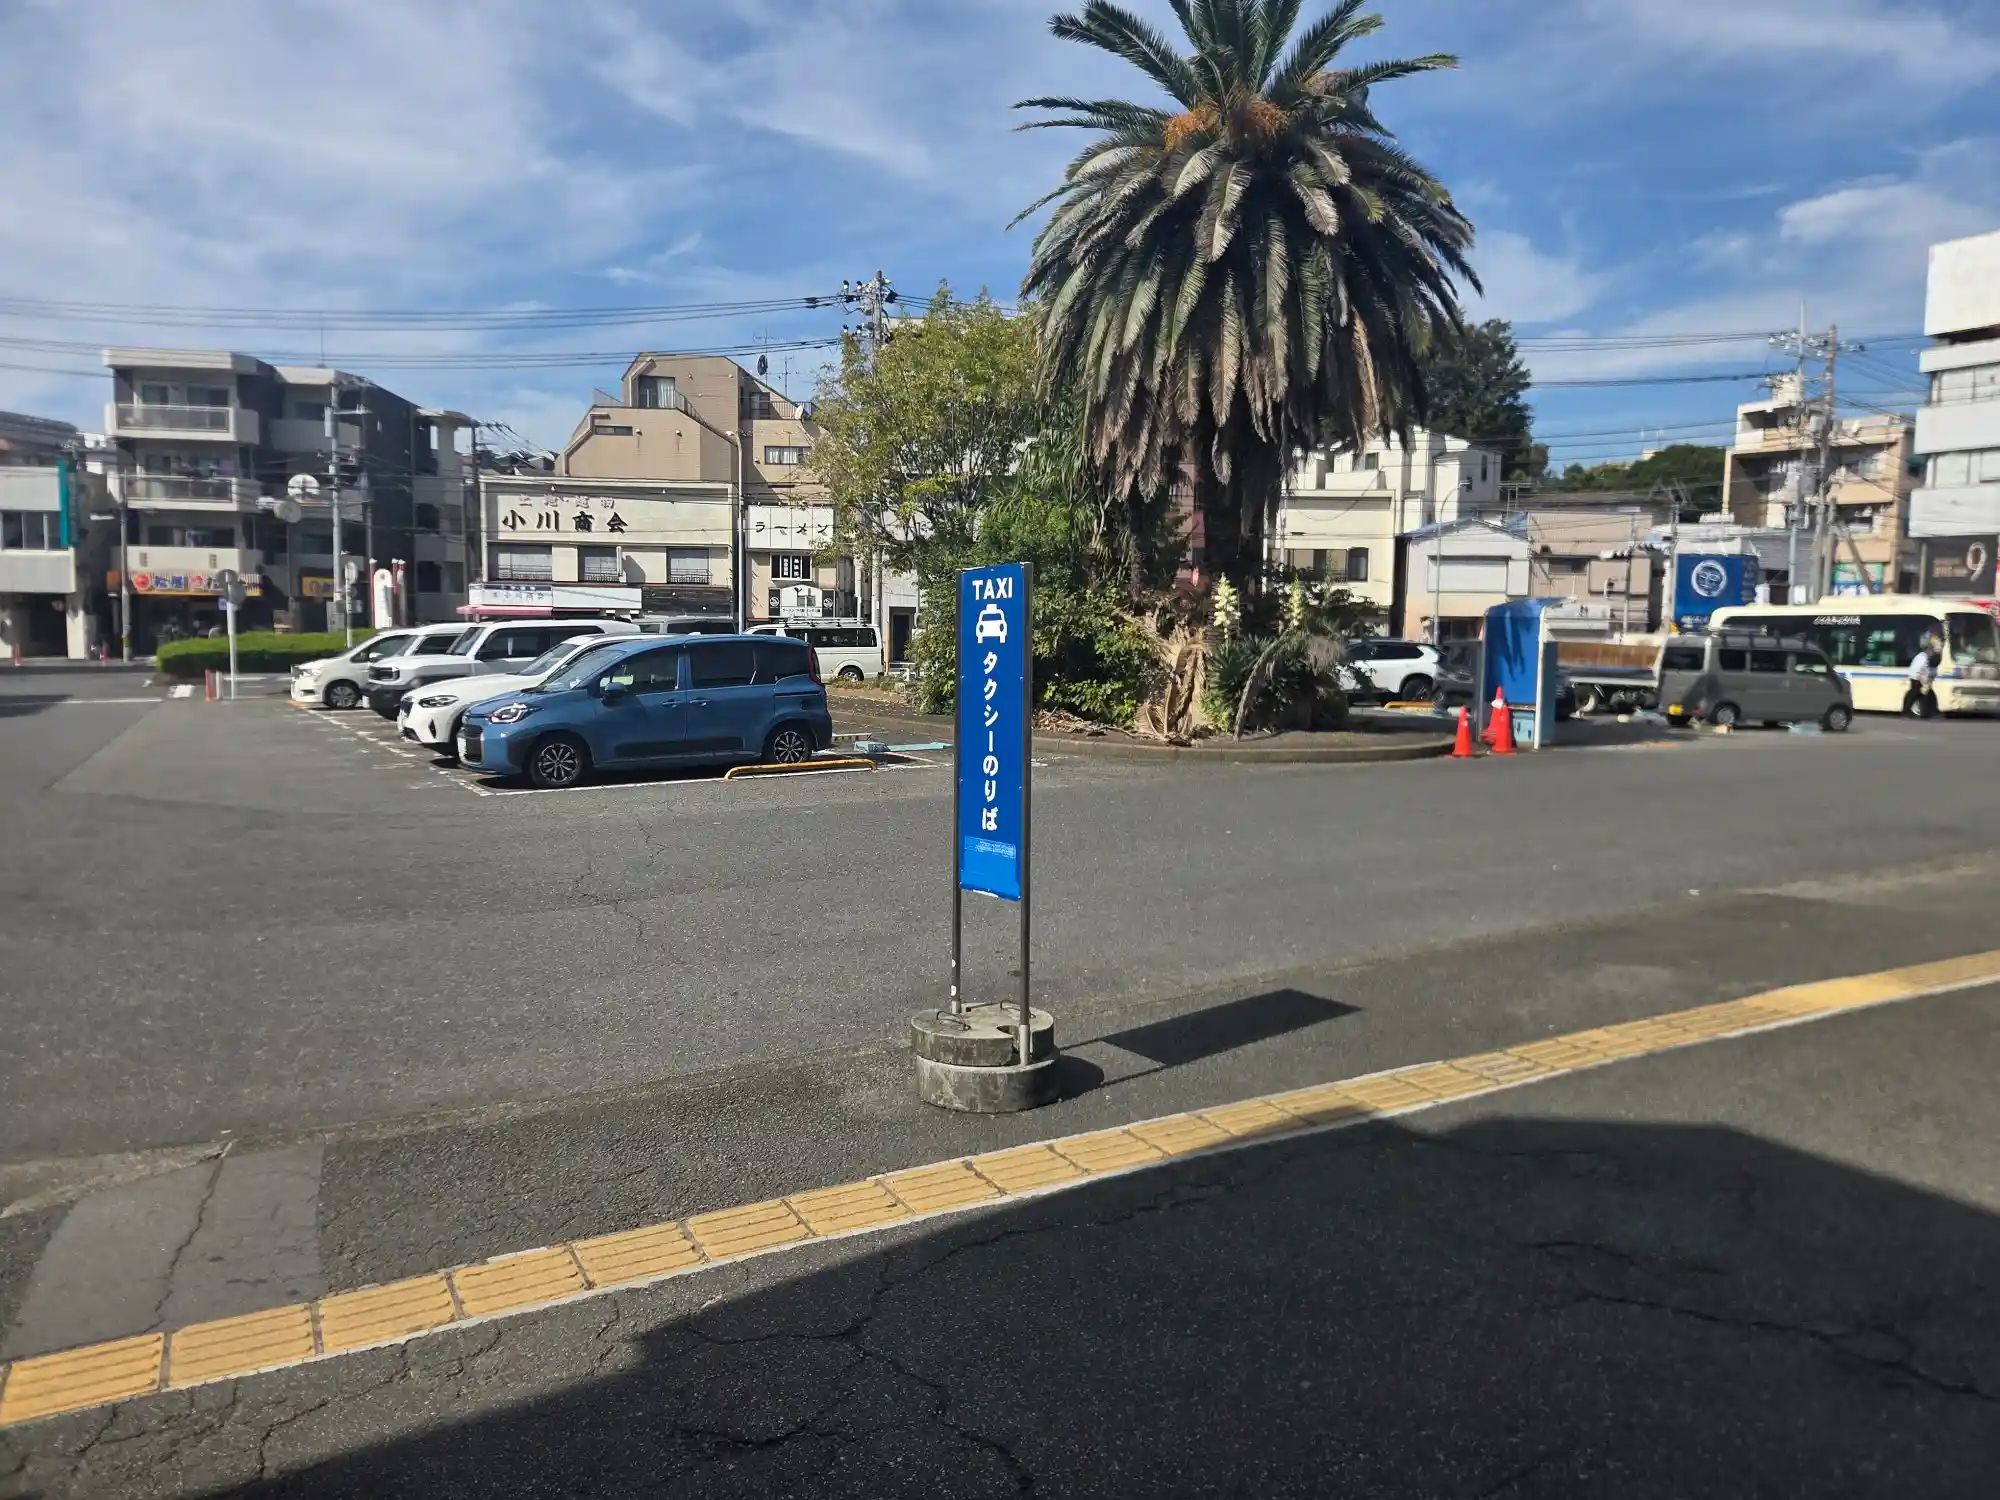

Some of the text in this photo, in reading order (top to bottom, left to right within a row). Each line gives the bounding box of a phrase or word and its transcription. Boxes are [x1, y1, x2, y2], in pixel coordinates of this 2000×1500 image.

[502, 509, 629, 534] 小川商会
[755, 521, 829, 534] ラーメン
[972, 577, 1013, 600] TAXI
[981, 651, 999, 831] タクシーのりば
